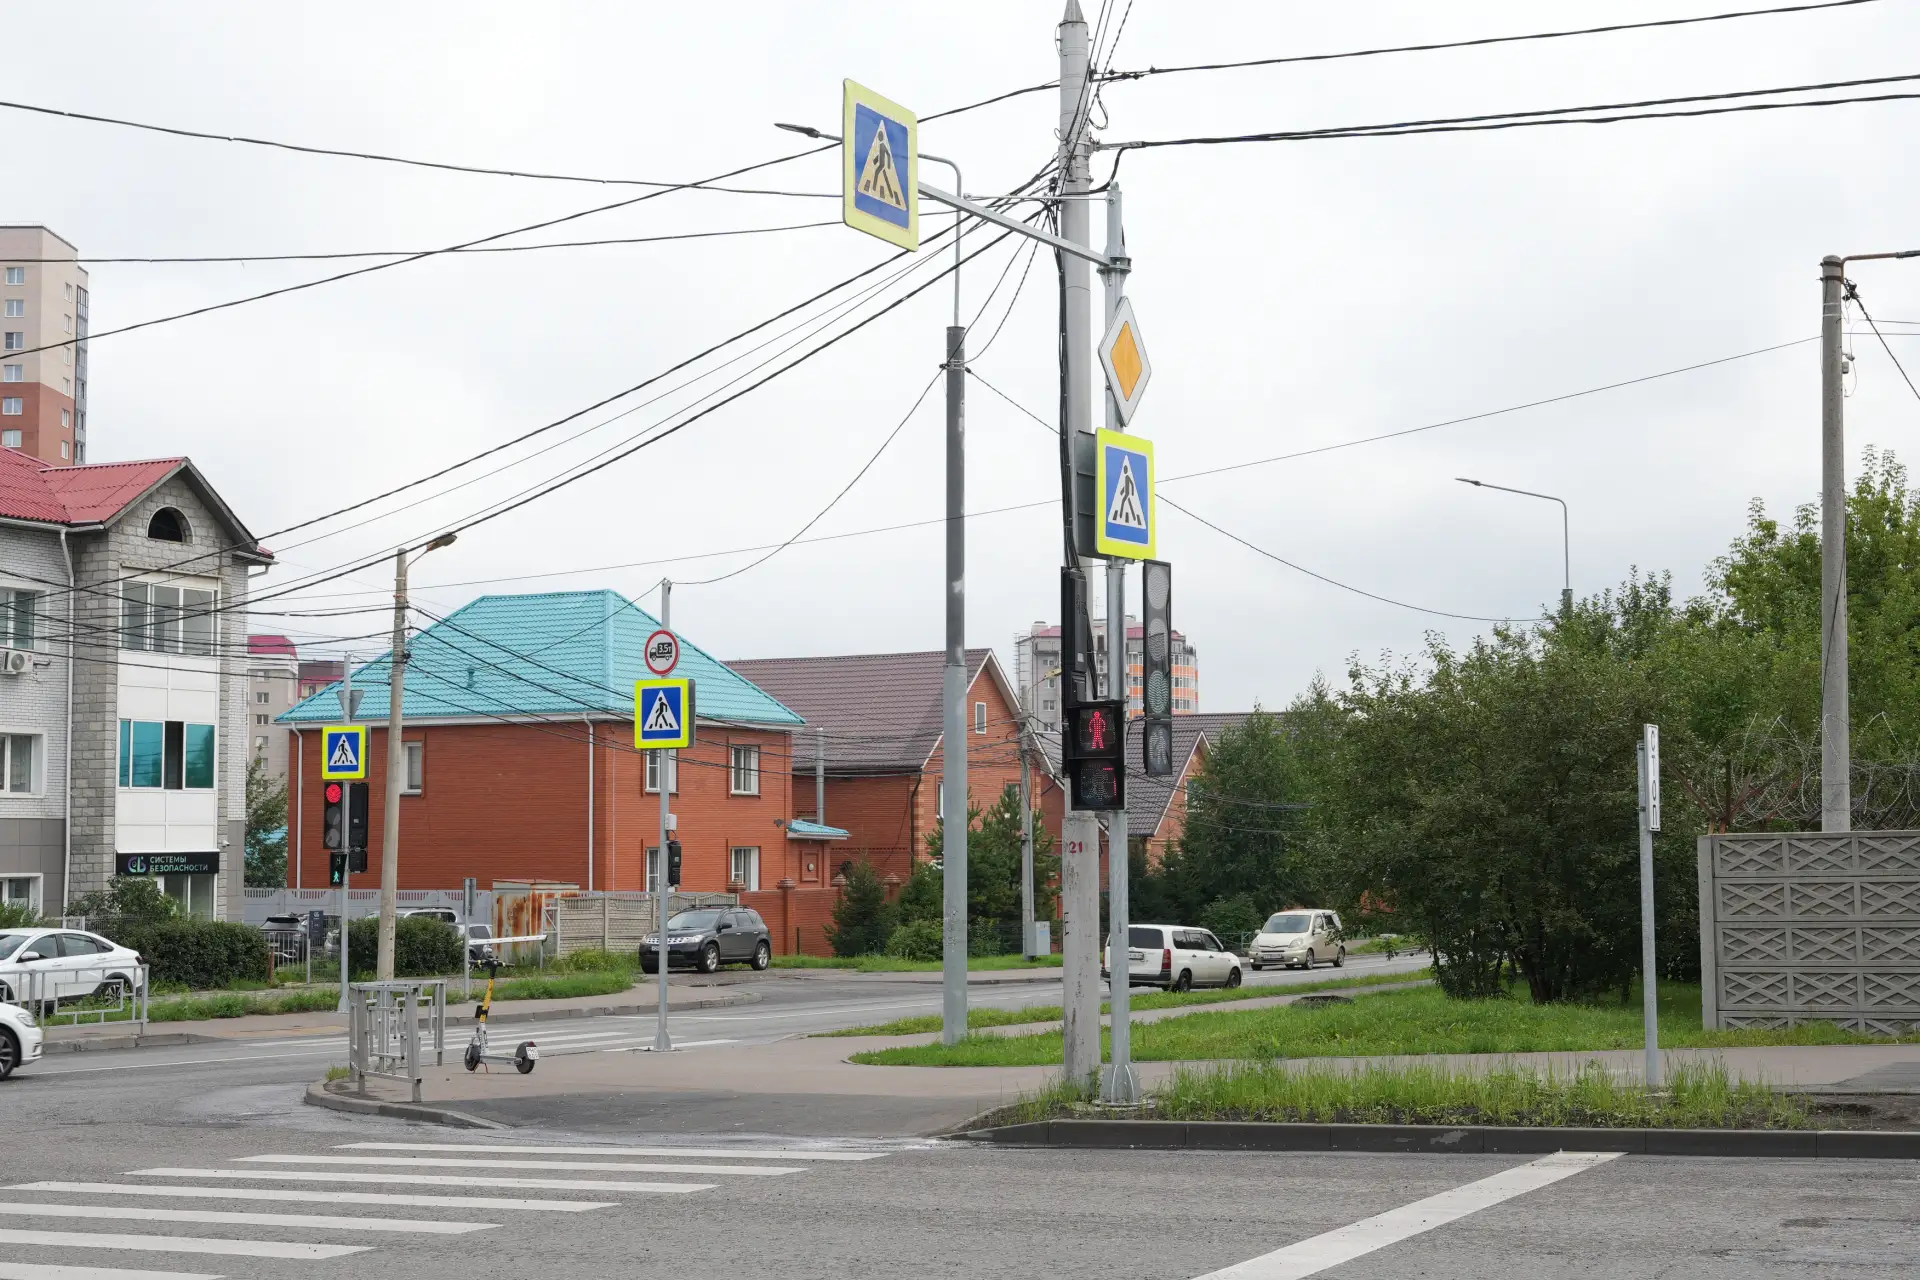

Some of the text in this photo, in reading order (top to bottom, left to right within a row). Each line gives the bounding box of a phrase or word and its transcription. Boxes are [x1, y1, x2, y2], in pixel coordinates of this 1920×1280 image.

[1068, 840, 1083, 854] 21
[149, 856, 187, 864] СИСТЕМЫ
[149, 864, 209, 872] БЕЗОПАСНОСТИ
